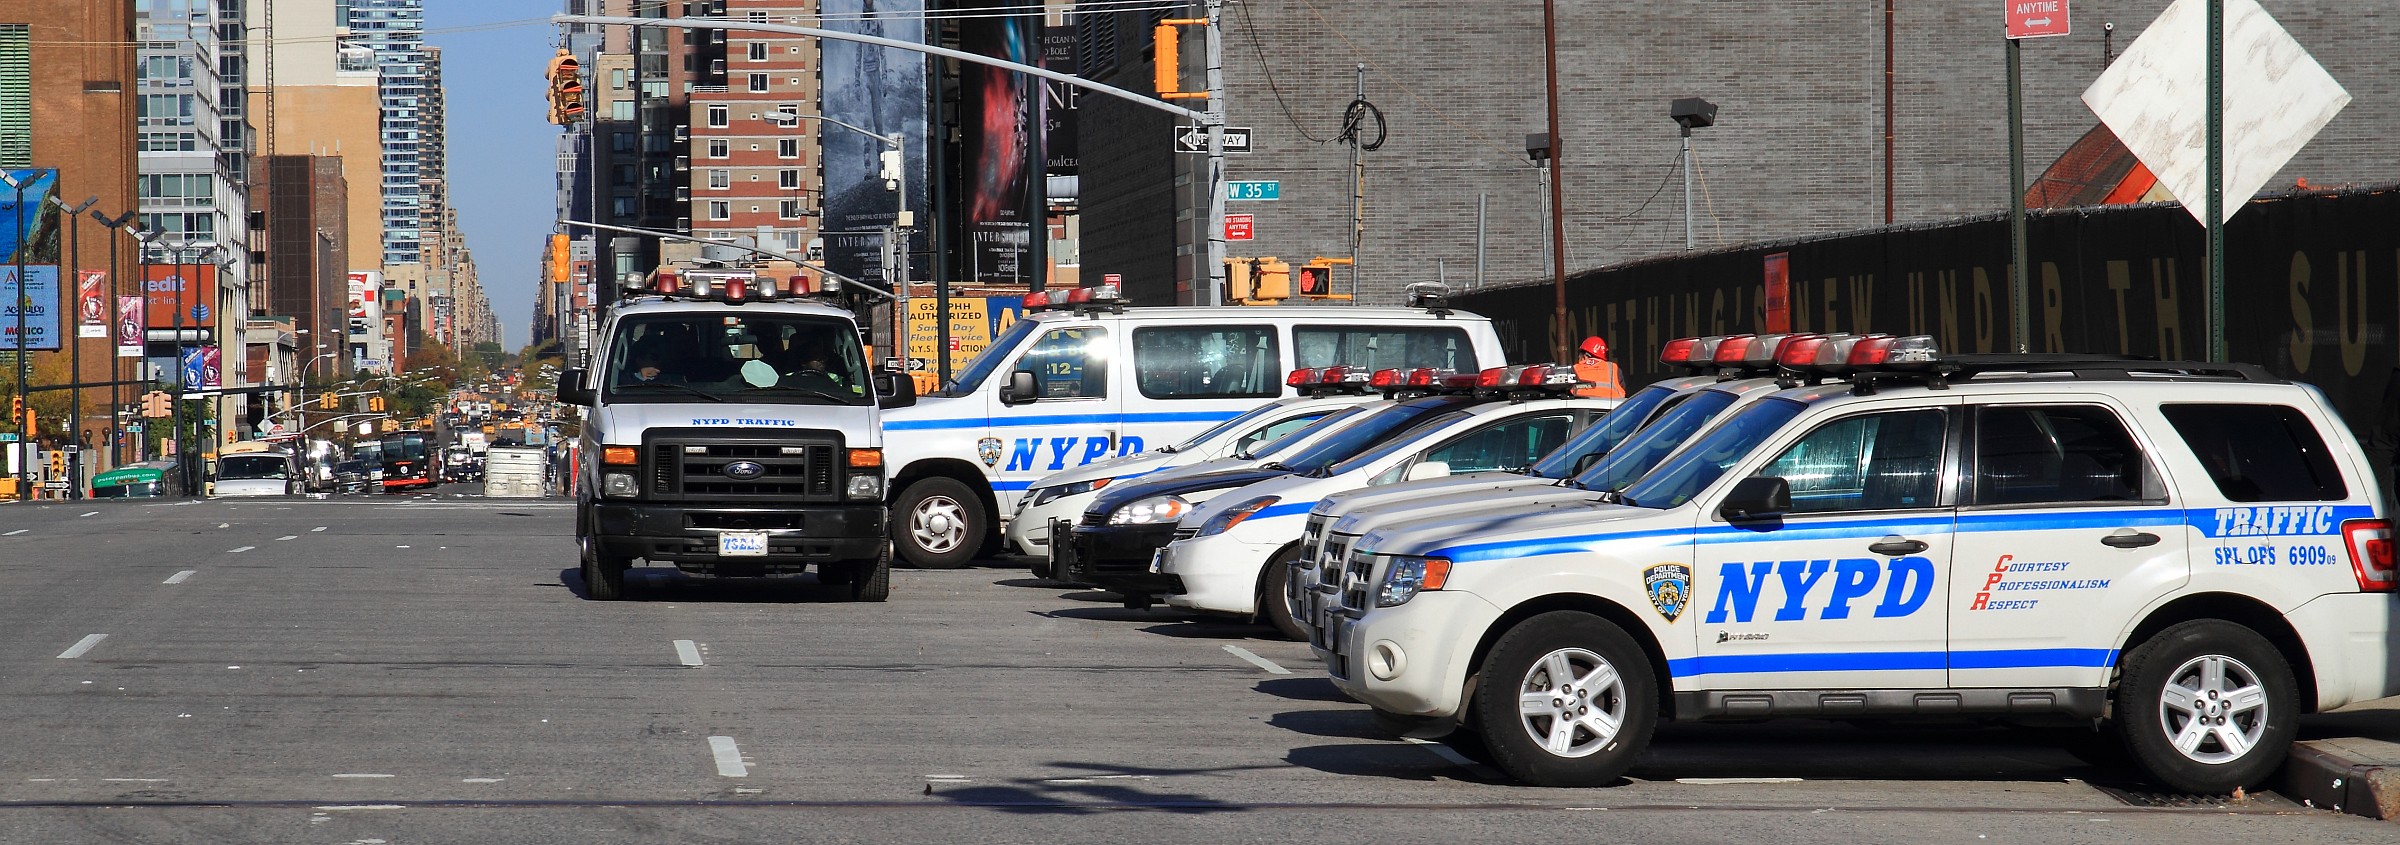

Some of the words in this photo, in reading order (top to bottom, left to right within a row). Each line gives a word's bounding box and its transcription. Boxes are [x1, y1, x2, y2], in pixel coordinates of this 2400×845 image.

[2016, 1, 2059, 15] ANYTIME
[1051, 36, 1070, 44] CLAN
[1229, 183, 1240, 198] W
[1245, 183, 1263, 198] 35
[1267, 183, 1276, 192] ST
[140, 275, 186, 292] redit
[163, 296, 185, 305] lin.
[920, 303, 938, 311] GS
[4, 305, 45, 314] ACULCO
[909, 311, 982, 320] AUTHRIZED
[1796, 273, 1874, 335] NEW
[1908, 261, 2064, 354] UNDR
[2106, 256, 2229, 362] TH
[2289, 248, 2400, 377] SU
[5, 326, 44, 336] MICO
[952, 323, 976, 335] Day
[692, 418, 730, 426] NYPD
[735, 418, 795, 427] TRAFFIC
[1005, 435, 1144, 472] NYPD
[734, 464, 756, 475] Ford
[97, 472, 156, 483] peterpanbus.com
[2214, 506, 2334, 537] TRAFFIC
[2214, 547, 2243, 565] SPL
[2288, 545, 2326, 566] 6909
[2326, 554, 2337, 565] 09
[1653, 564, 1681, 574] POLICE
[1994, 554, 2071, 573] COURTESY
[1645, 571, 1690, 585] DEPARTMENT
[1982, 573, 2112, 592] PROFESSIONALISM
[1704, 556, 1936, 624] NYPD
[1648, 589, 1659, 606] CITY
[1657, 605, 1667, 615] OF
[1673, 602, 1685, 617] NEW
[1681, 585, 1691, 604] YORK
[1969, 592, 2039, 611] RESPECT
